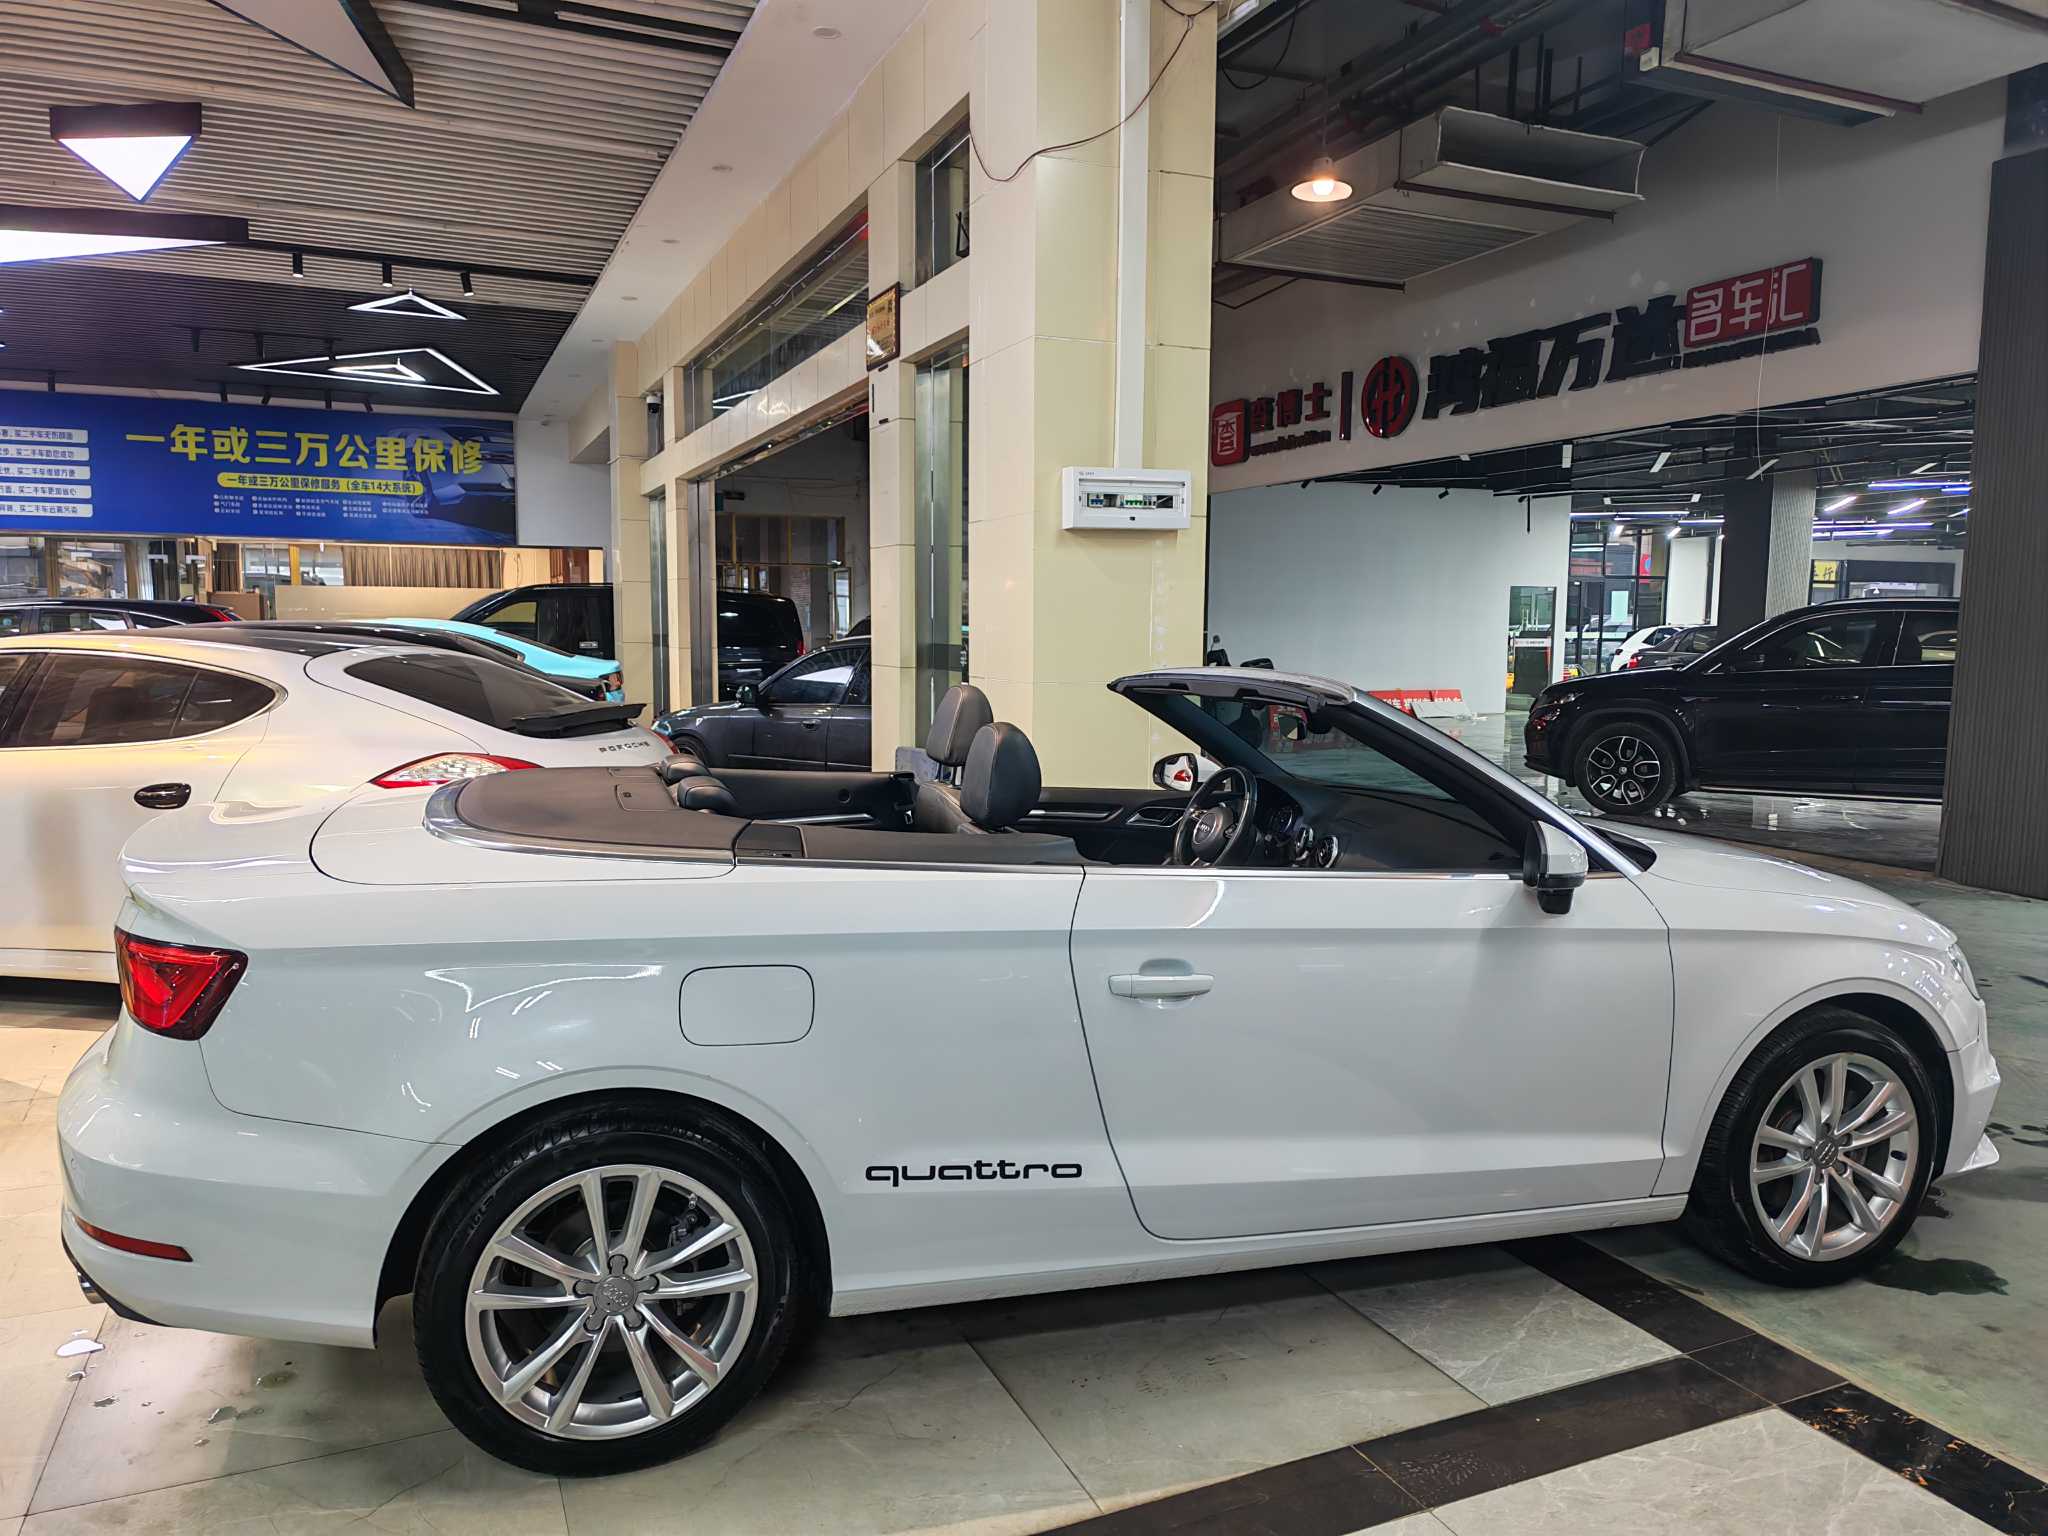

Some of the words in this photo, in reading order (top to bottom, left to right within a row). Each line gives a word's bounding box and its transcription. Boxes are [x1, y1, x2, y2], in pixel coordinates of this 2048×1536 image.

[1690, 263, 1808, 342] 名车汇
[125, 422, 485, 475] 一年或三万公里保修
[599, 741, 650, 752] PORSCHE
[865, 1159, 1083, 1188] quattro
